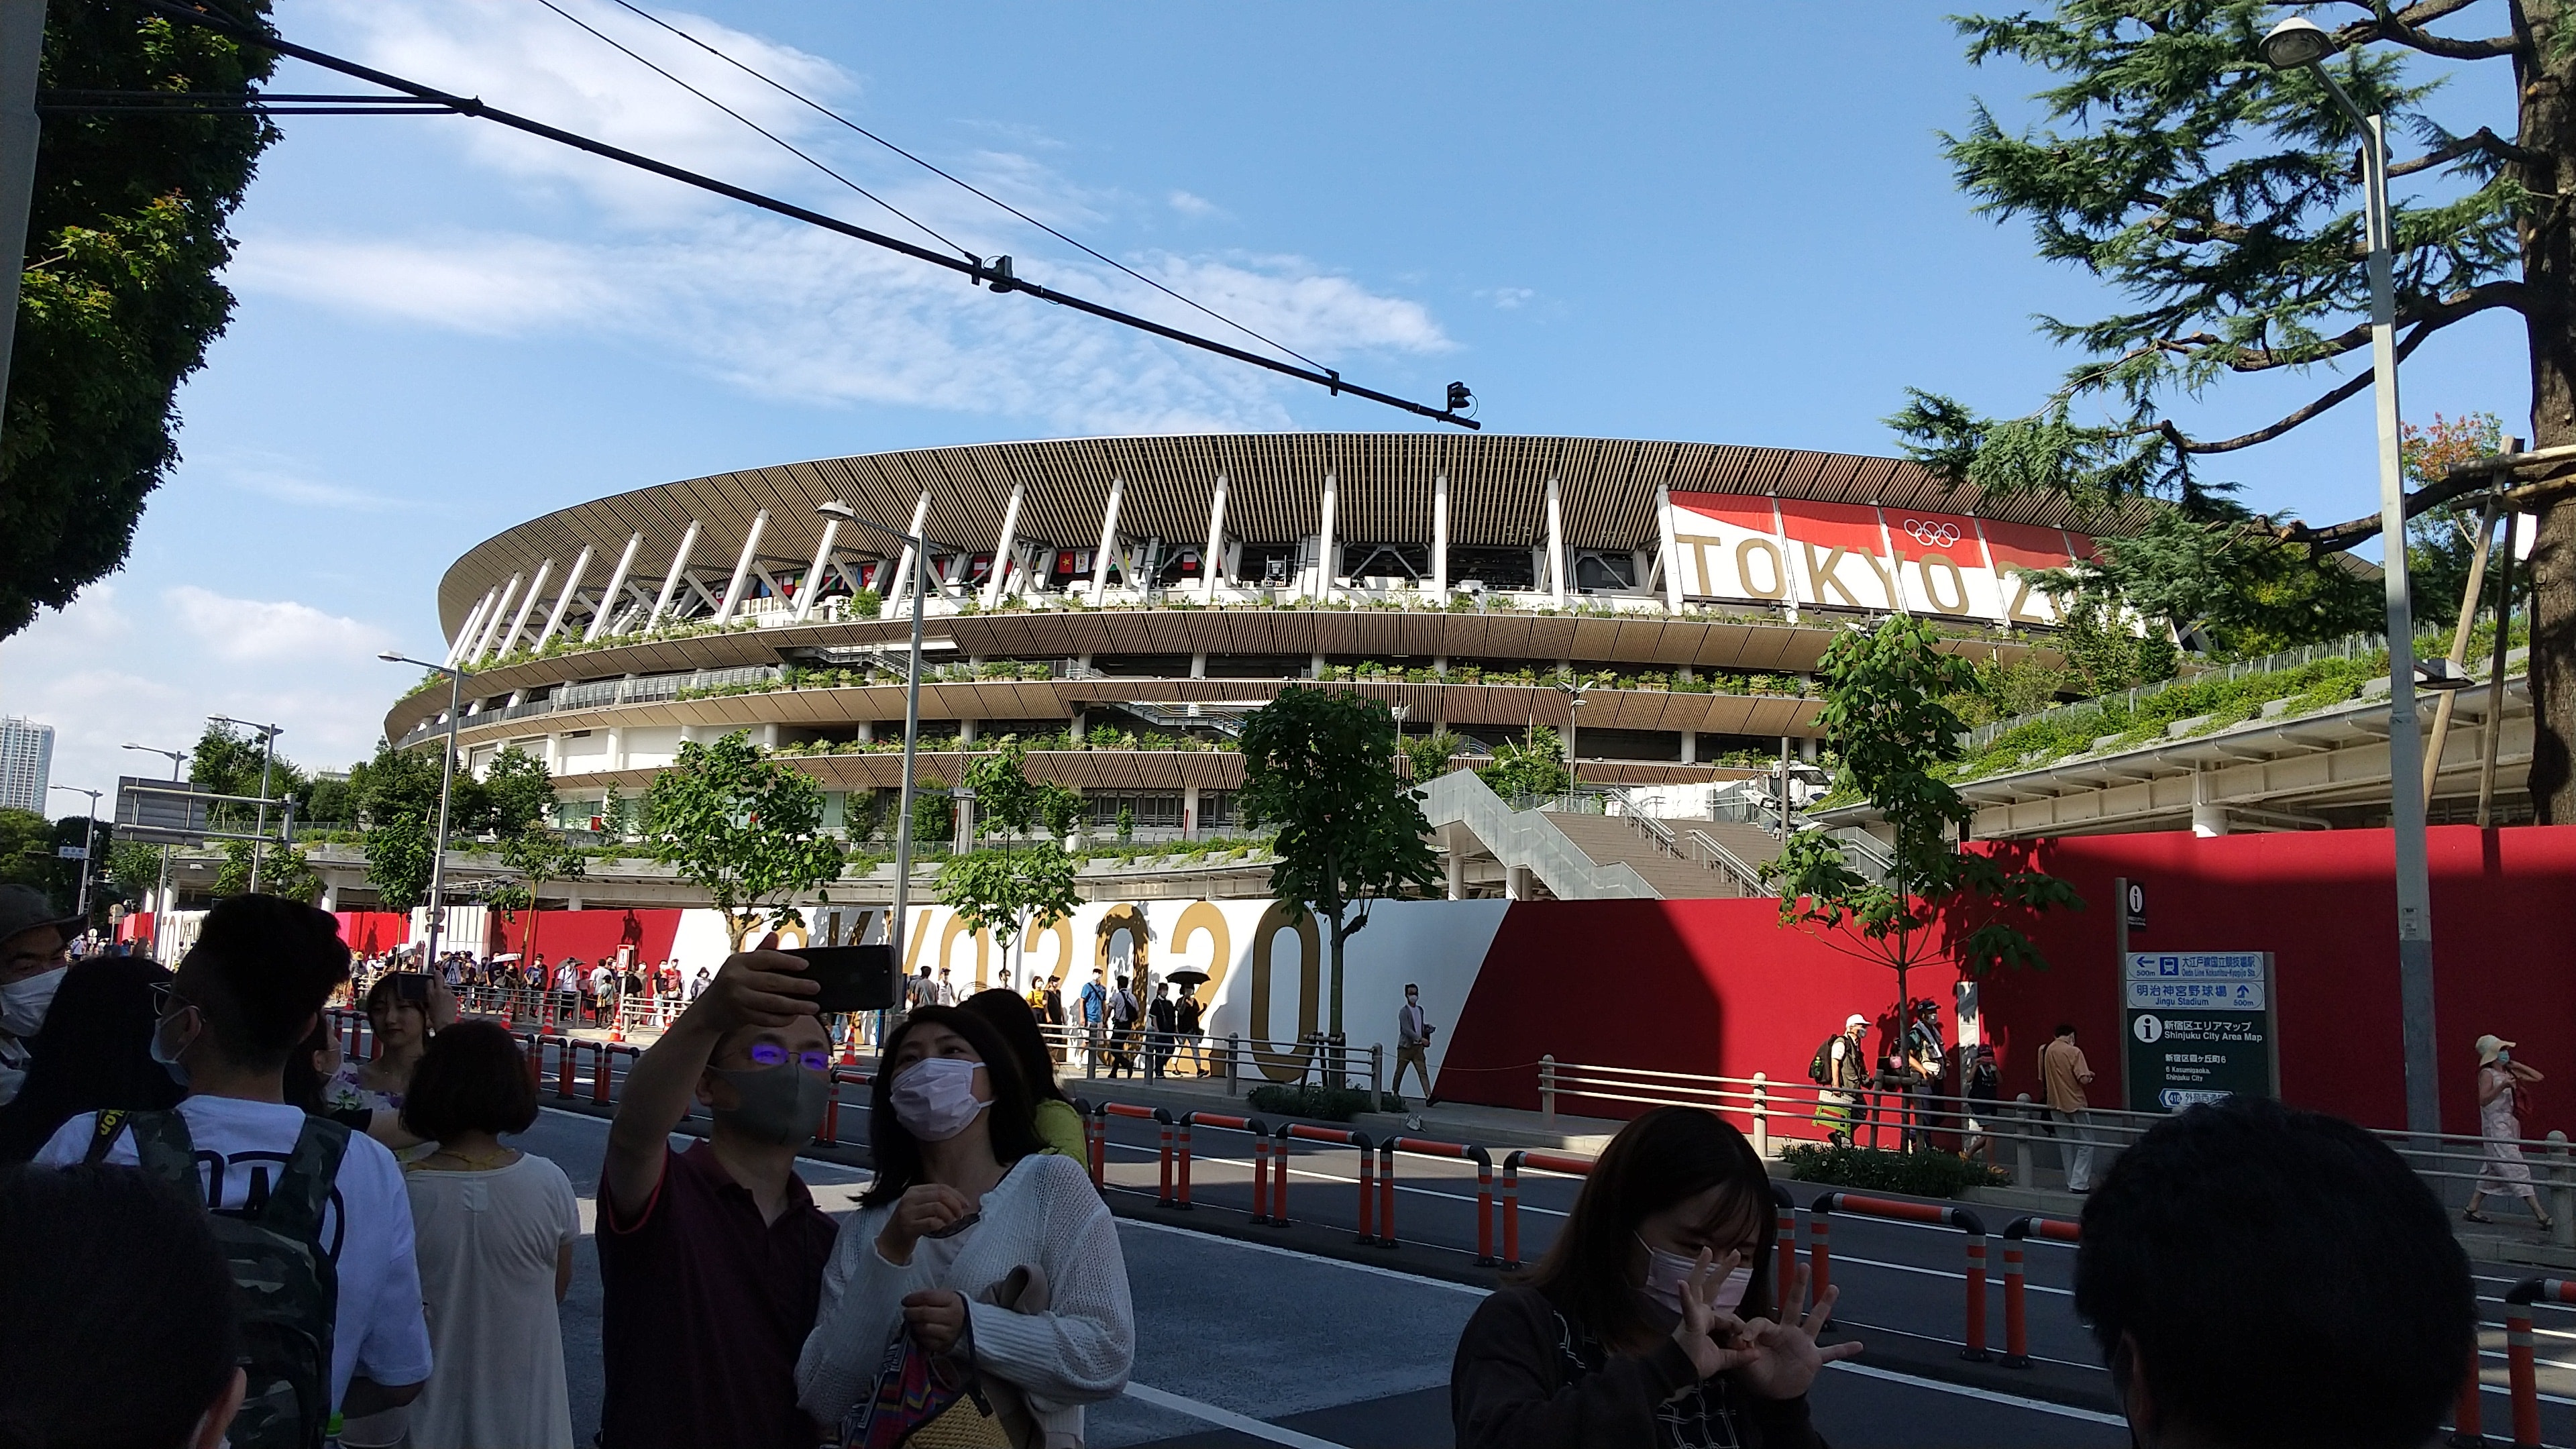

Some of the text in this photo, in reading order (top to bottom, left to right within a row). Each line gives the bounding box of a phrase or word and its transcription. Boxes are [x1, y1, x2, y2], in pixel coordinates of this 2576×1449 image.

[1676, 534, 1970, 616] TOKYO
[2137, 985, 2227, 997] 明治神宮野球場
[2155, 998, 2209, 1006] Jingu Stadium
[2164, 1020, 2251, 1032] 新宿区エリアマップ
[2164, 1031, 2201, 1040] Shinjuku
[2203, 1032, 2220, 1042] City
[2244, 1033, 2263, 1043] Map
